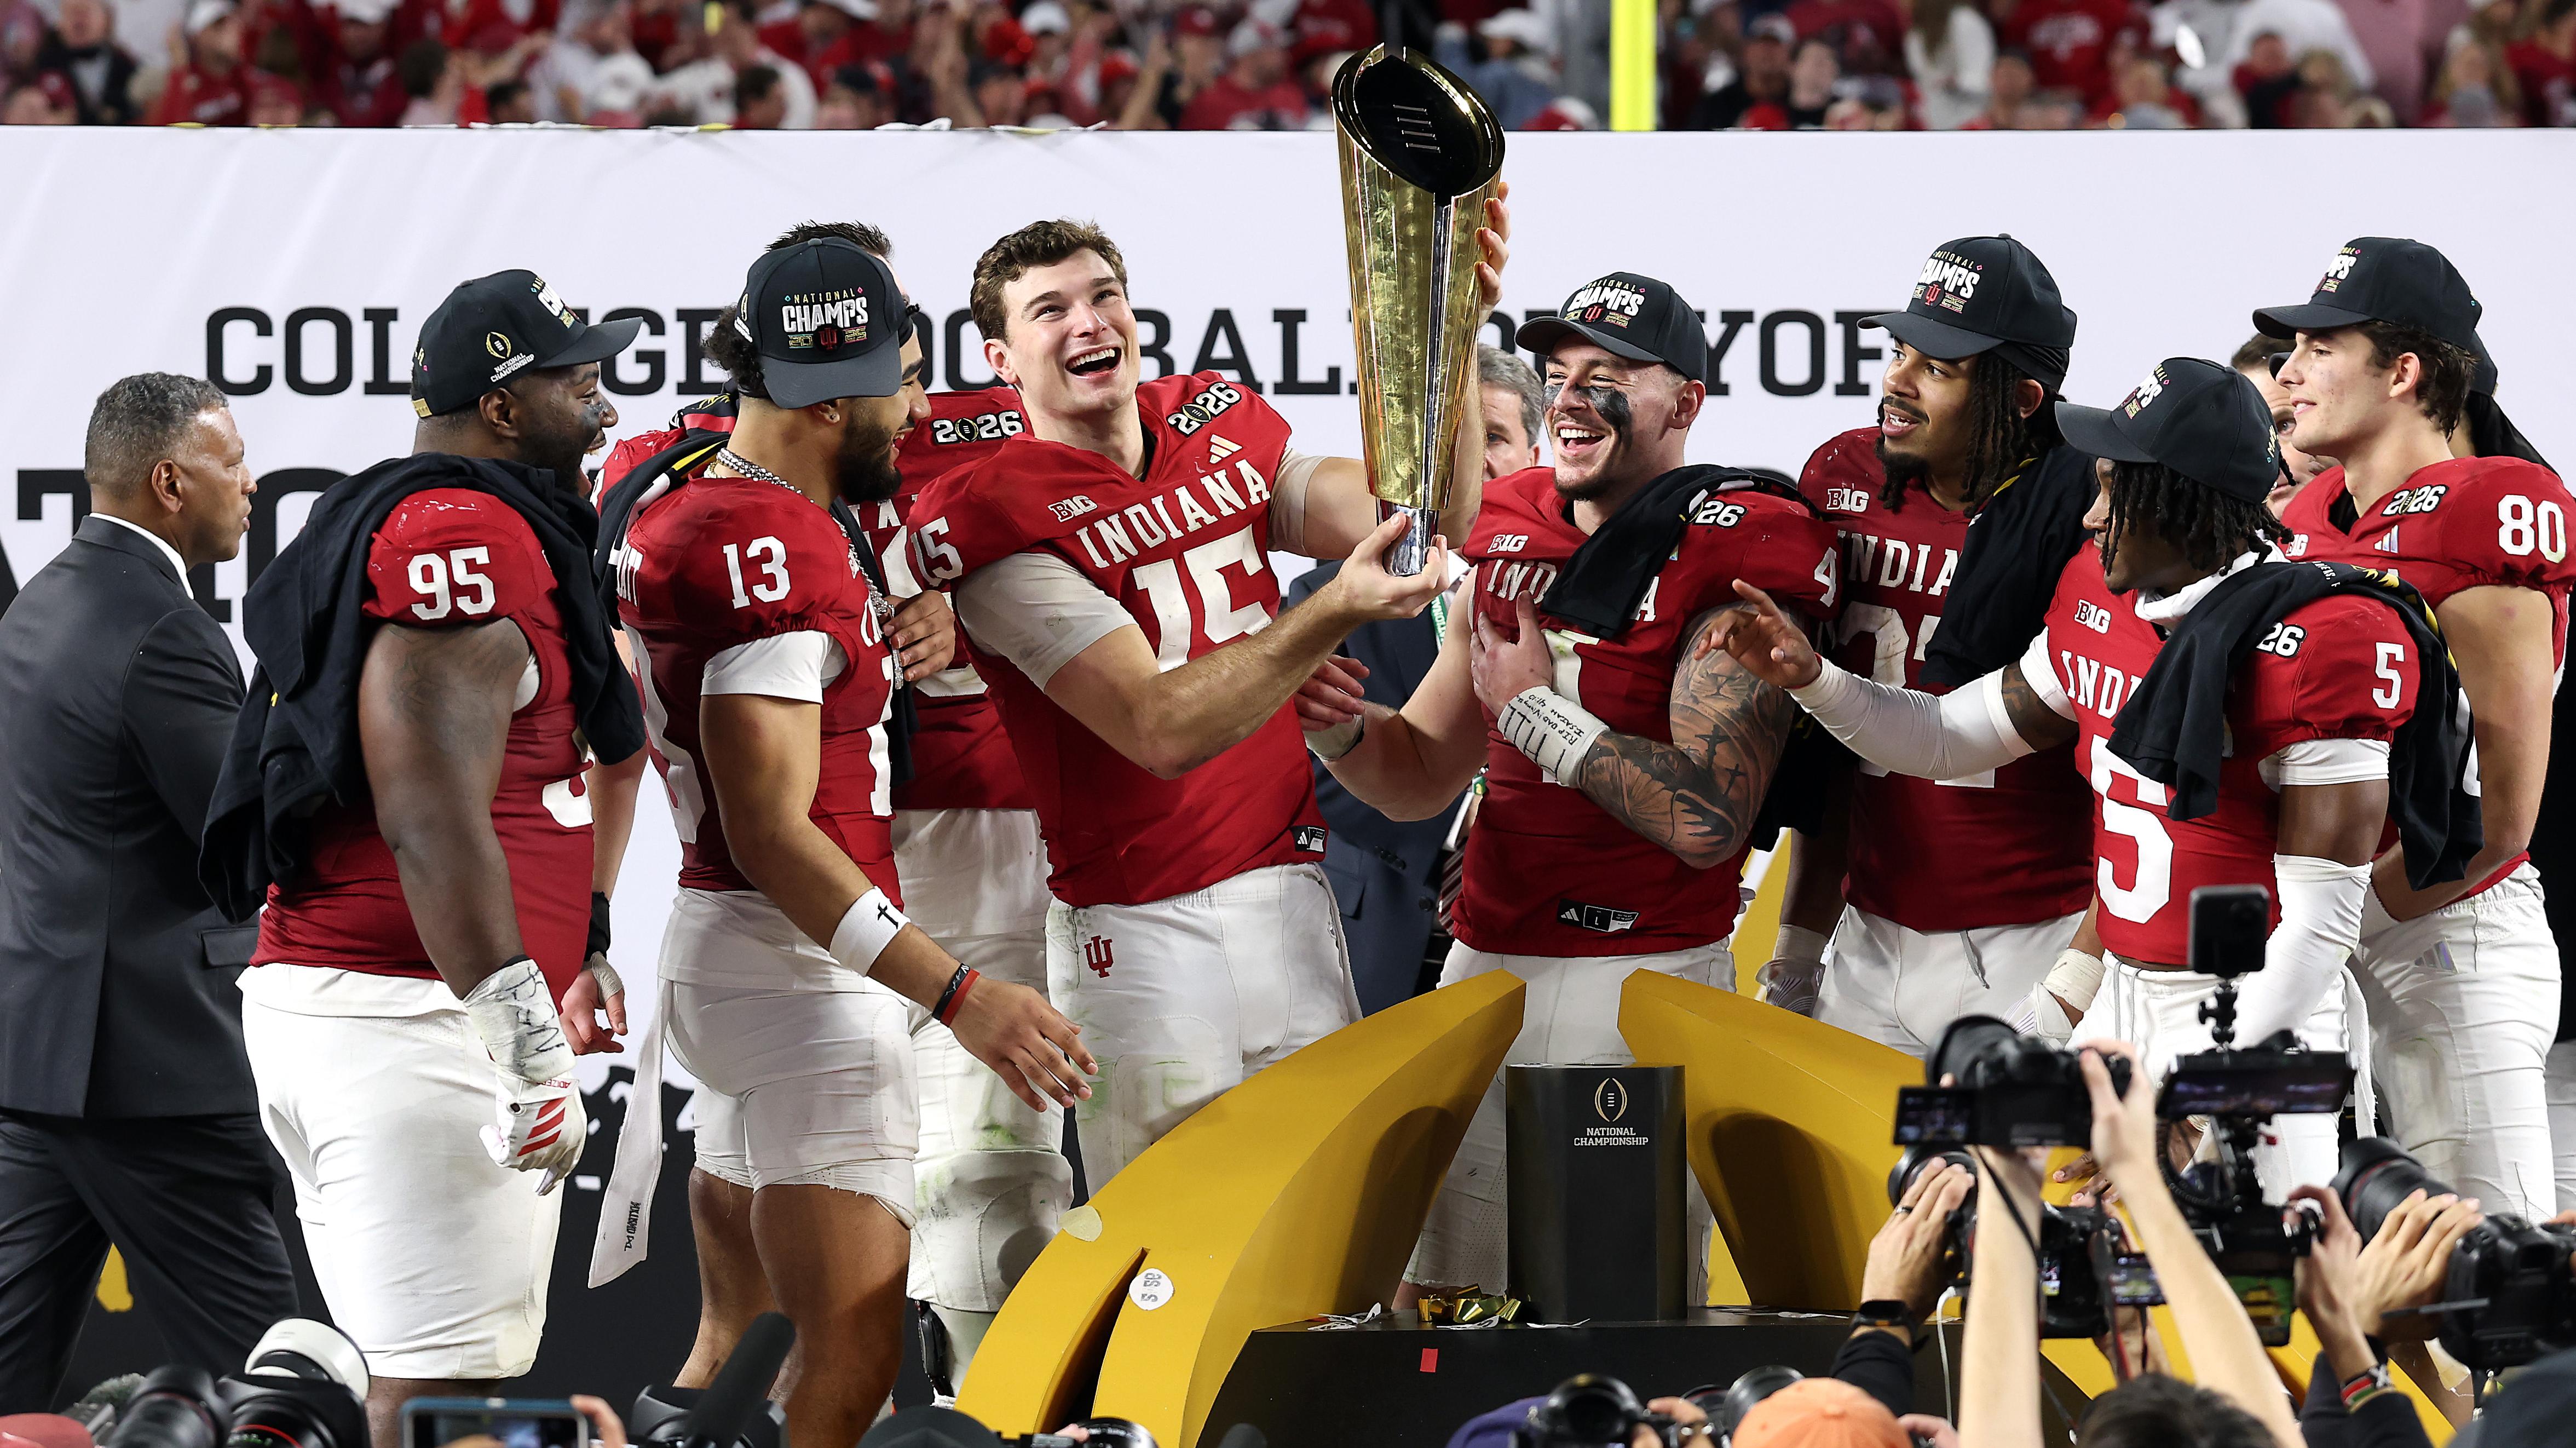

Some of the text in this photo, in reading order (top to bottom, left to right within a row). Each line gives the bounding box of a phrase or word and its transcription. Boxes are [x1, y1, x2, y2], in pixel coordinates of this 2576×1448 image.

[1934, 251, 1974, 269] NATIONAL
[794, 288, 855, 304] NATIONAL
[1586, 279, 1636, 291] NATIONAL
[782, 296, 869, 332] CHAMPS
[1567, 286, 1645, 316] CHAMPS
[490, 354, 534, 382] CHAMPIONSHIP
[494, 353, 526, 374] NATIONAL
[1076, 459, 1271, 568] INDIANA
[2498, 494, 2567, 564] 80
[910, 516, 964, 587] 15
[407, 545, 496, 621] 95
[722, 536, 791, 610] 13
[1814, 547, 1837, 607] 4
[1133, 524, 1272, 673] 15
[2372, 642, 2404, 709] 5
[1551, 709, 1584, 737] ISAIAH
[1559, 729, 1578, 745] RIP
[2090, 734, 2174, 924] 5
[1595, 916, 1599, 926] L
[1574, 1137, 1649, 1146] CHAMPIONSHIP
[1586, 1127, 1636, 1136] NATIONAL
